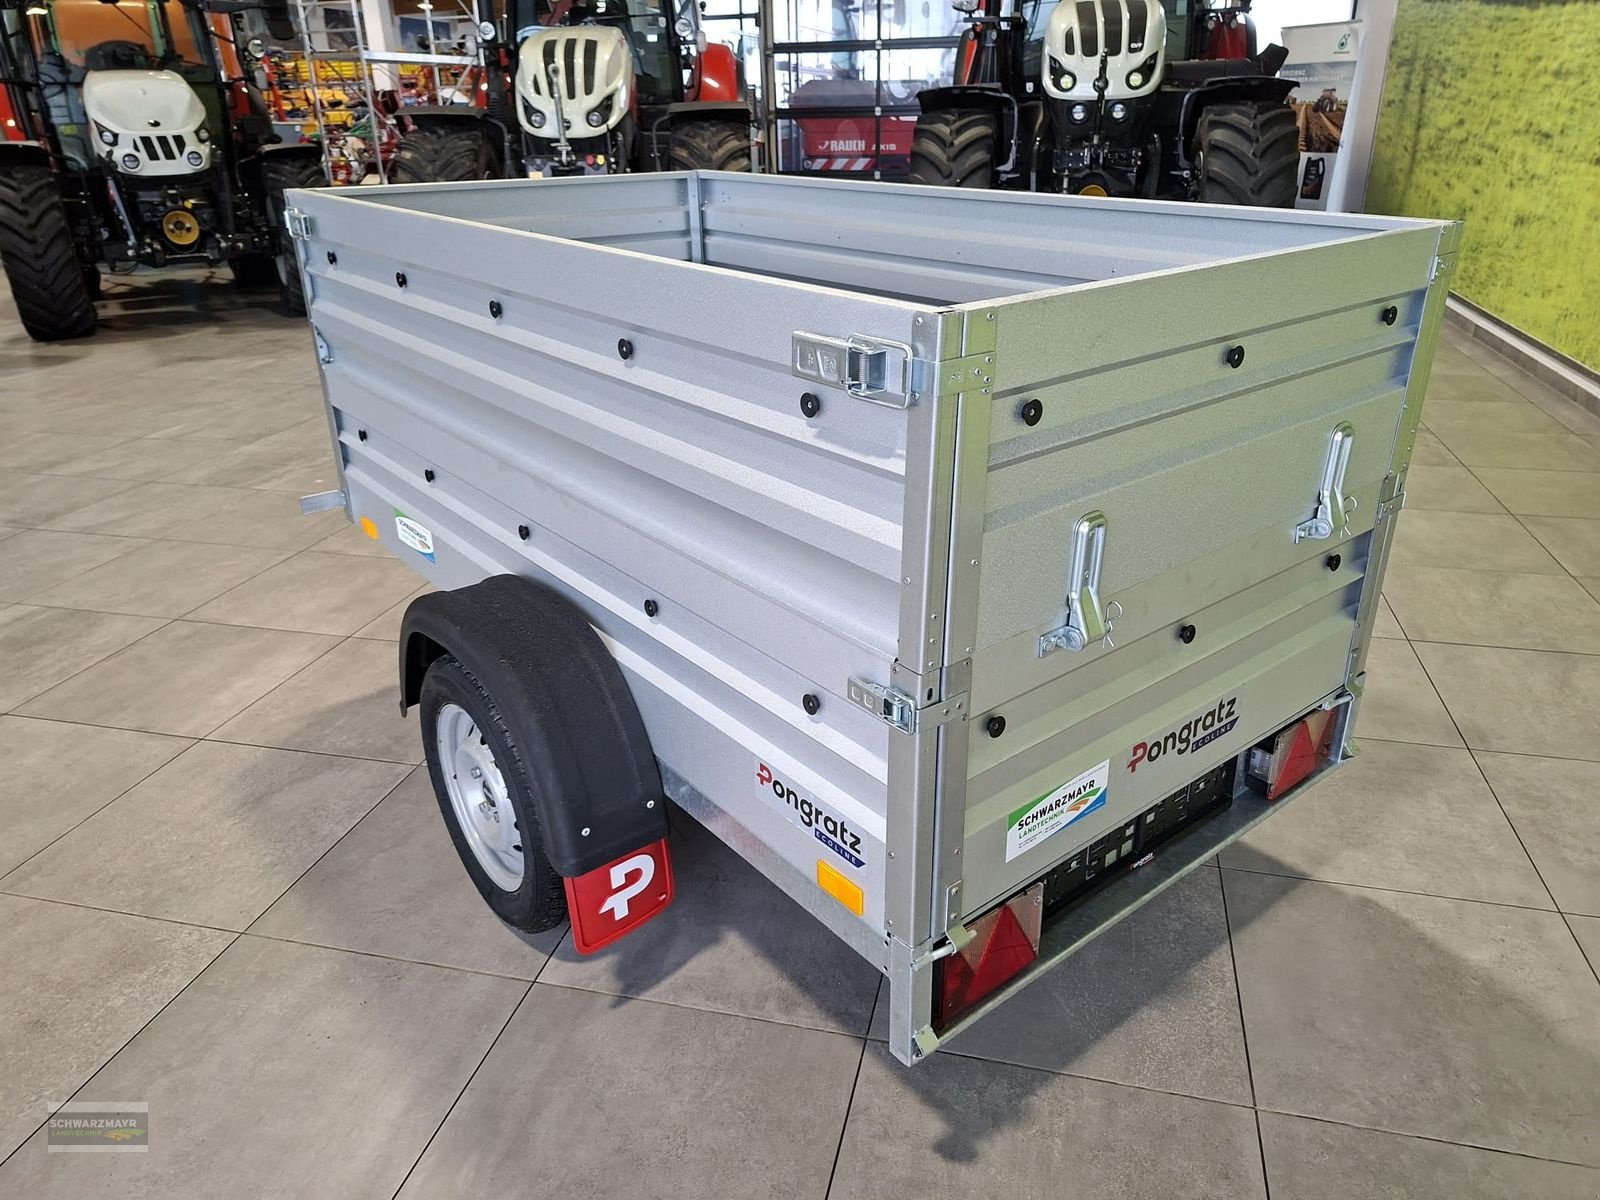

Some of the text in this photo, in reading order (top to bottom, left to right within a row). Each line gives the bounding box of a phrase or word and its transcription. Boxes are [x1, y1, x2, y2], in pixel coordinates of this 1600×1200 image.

[830, 140, 865, 151] RAUCH
[1126, 696, 1237, 773] Pongratz
[1192, 722, 1234, 751] ECOLINE
[756, 762, 862, 855] Pongratz
[1017, 779, 1096, 831] SCHWARZMAYR
[1018, 808, 1065, 839] LANDTECHNIK
[815, 830, 857, 864] ECOLINE
